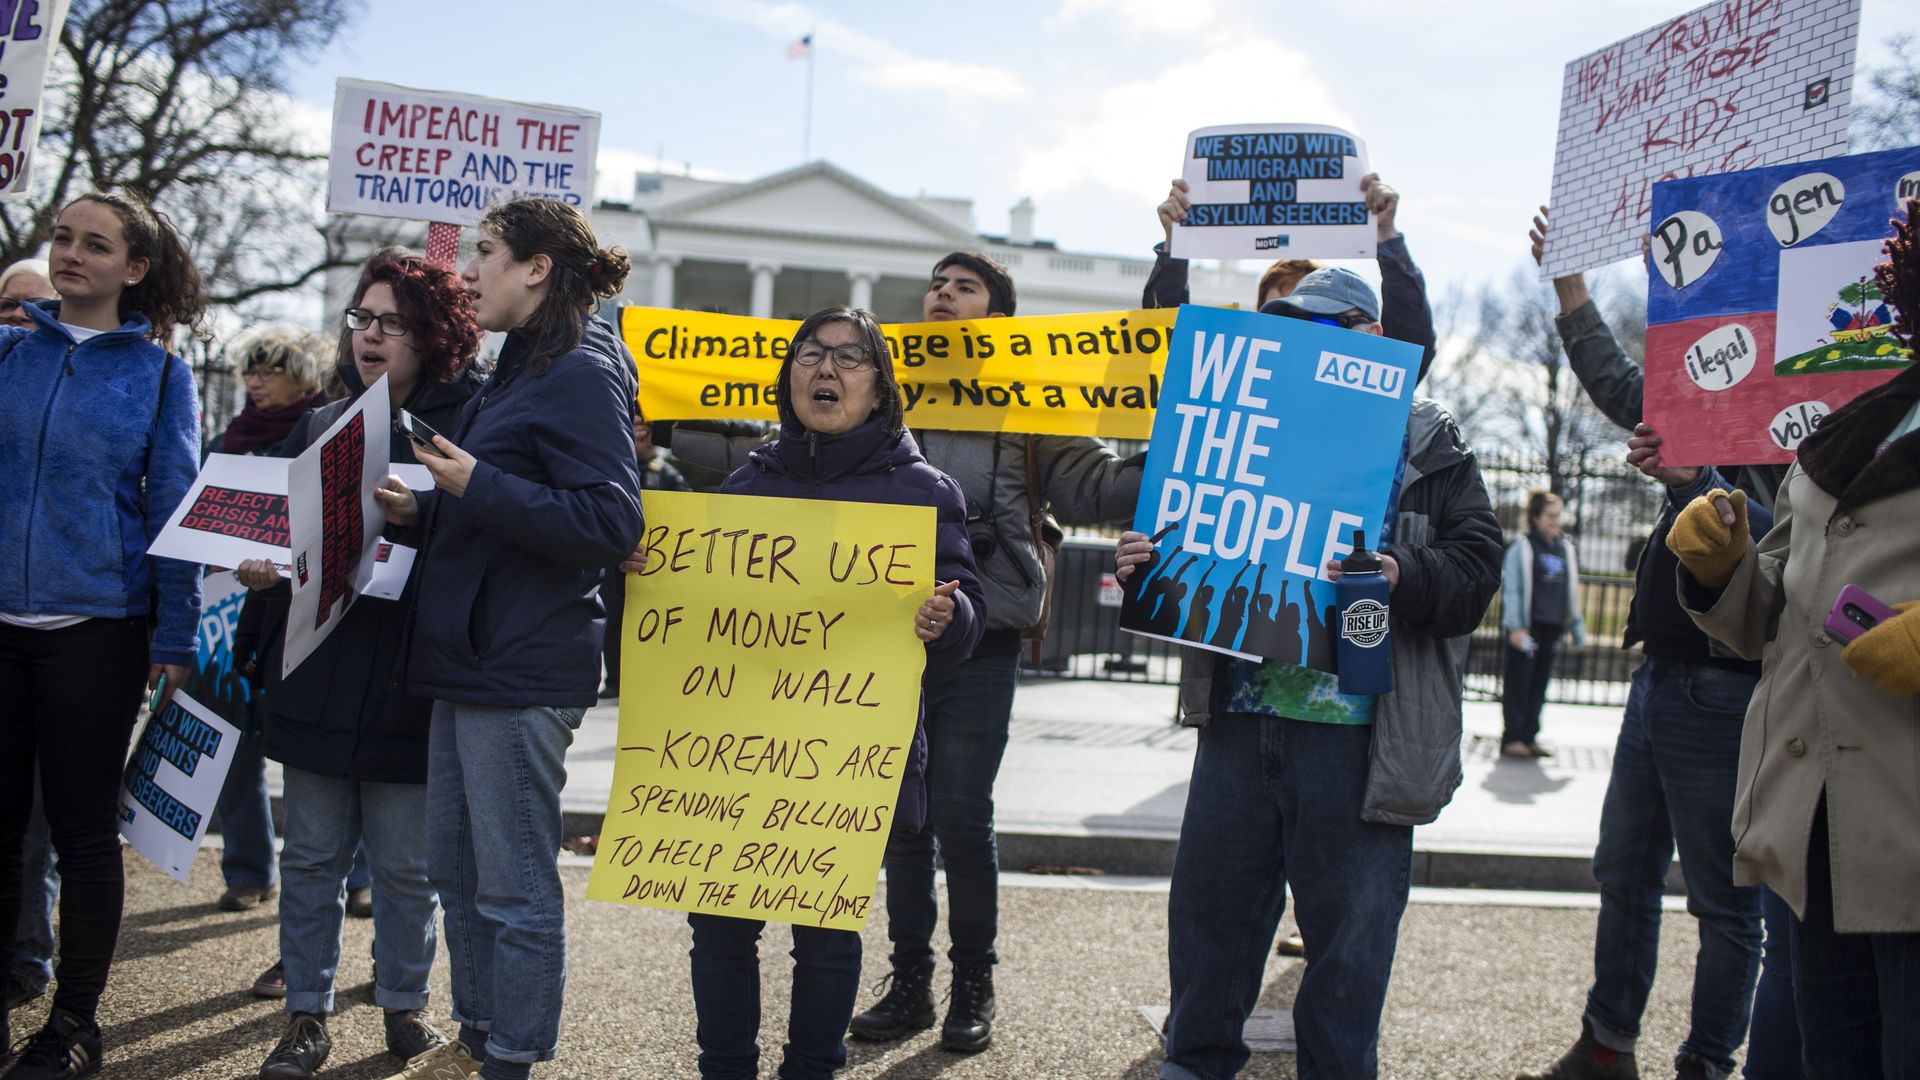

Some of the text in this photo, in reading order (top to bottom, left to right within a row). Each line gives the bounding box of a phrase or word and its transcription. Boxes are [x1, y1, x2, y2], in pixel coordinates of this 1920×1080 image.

[1577, 43, 1625, 104] HEY!
[1596, 28, 1780, 135] LEAVE THOSE
[363, 98, 581, 153] IMPEACH THE
[1195, 134, 1357, 158] WE STAND WITH
[1642, 86, 1745, 164] KIDS
[355, 142, 574, 190] CREEP AND THE
[1208, 157, 1342, 180] IMMIGRANTS
[1251, 181, 1296, 202] AND
[1272, 203, 1366, 225] SEEKERS
[1653, 216, 1723, 290] Pa
[1769, 181, 1844, 246] gen
[644, 325, 790, 360] Climate
[960, 327, 995, 358] is
[1010, 333, 1033, 356] a
[1686, 327, 1749, 385] ilegal
[950, 377, 1031, 407] Not
[1041, 385, 1066, 409] a
[1081, 374, 1159, 409] wal
[1188, 330, 1282, 410] WE
[1321, 356, 1400, 394] ACLU
[1172, 403, 1280, 487] THE
[192, 501, 261, 525] CRISIS
[261, 513, 291, 530] AN
[200, 486, 278, 510] REJECT
[181, 515, 291, 547] DEPORTATI
[1154, 477, 1364, 583] PEOPLE
[637, 525, 917, 586] BETTER USE
[637, 605, 846, 650] OF MONEY
[1347, 613, 1386, 631] RISE UP
[682, 664, 881, 708] ON WALL
[178, 711, 221, 756] WITH
[836, 743, 901, 780] ARE
[134, 775, 199, 842] SEEKERS
[621, 785, 889, 833] SPENDING BILLIONS
[609, 835, 837, 878] TO HELP BRING
[622, 873, 686, 903] DOWN
[698, 880, 739, 907] THE
